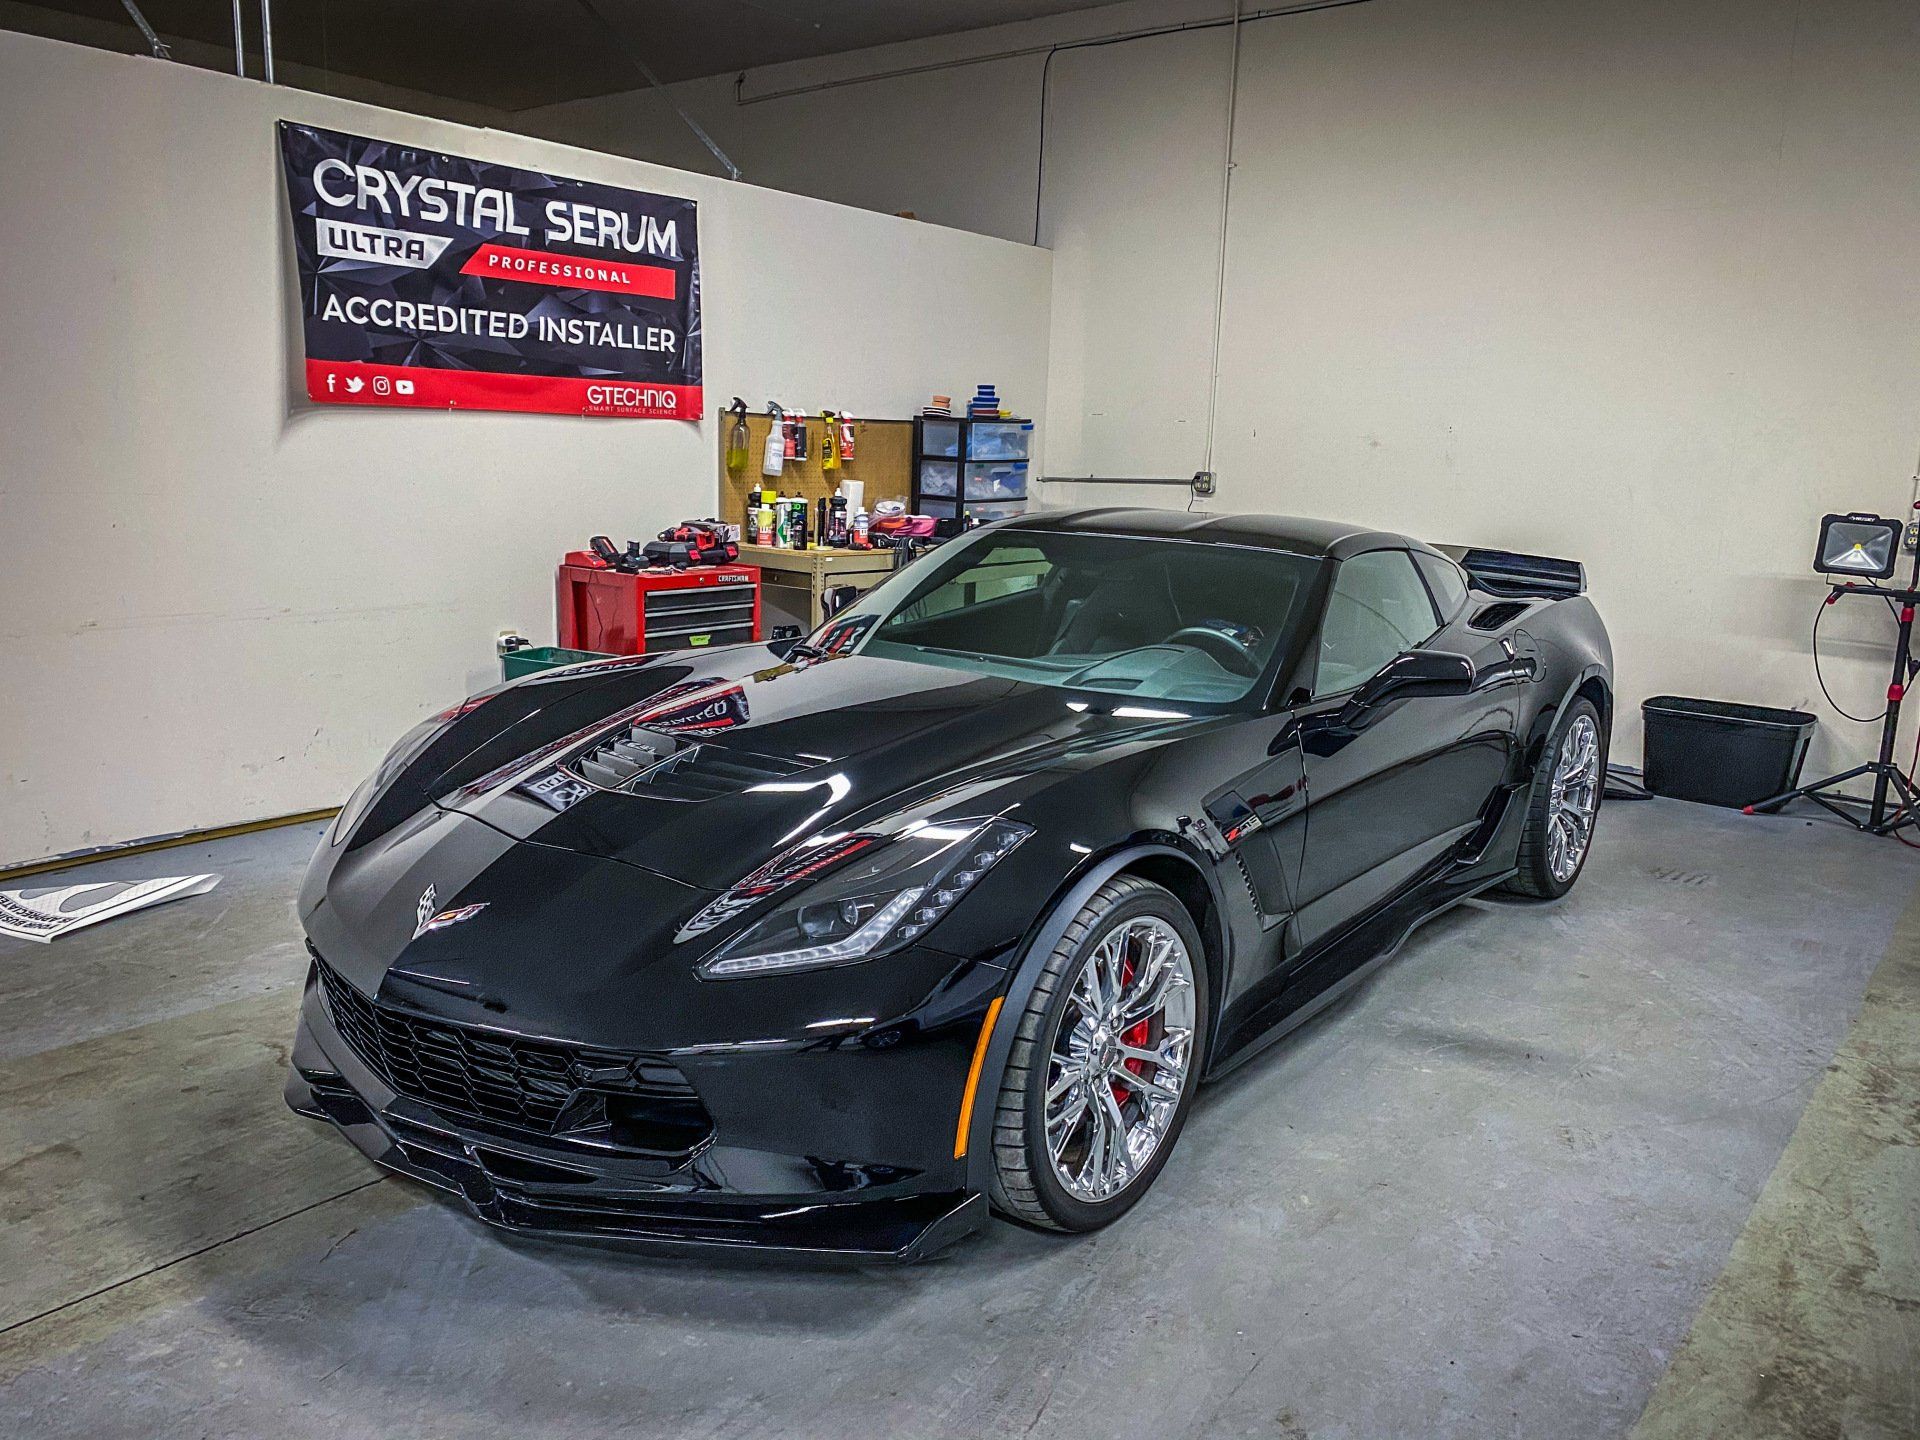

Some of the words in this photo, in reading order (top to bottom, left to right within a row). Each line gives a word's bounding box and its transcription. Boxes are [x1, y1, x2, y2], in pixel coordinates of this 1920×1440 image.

[312, 158, 530, 236] CRYSTAL
[546, 200, 677, 258] SERUM
[328, 227, 425, 261] ULTRA
[488, 254, 631, 285] PROFESSIONAL
[322, 293, 529, 340] ACCREDITED
[539, 316, 676, 353] INSTALLER
[587, 385, 677, 409] GTECHNIQ
[616, 406, 646, 414] SURFACE
[648, 408, 677, 416] SCIENCE
[718, 574, 749, 583] CRAFTSMAN
